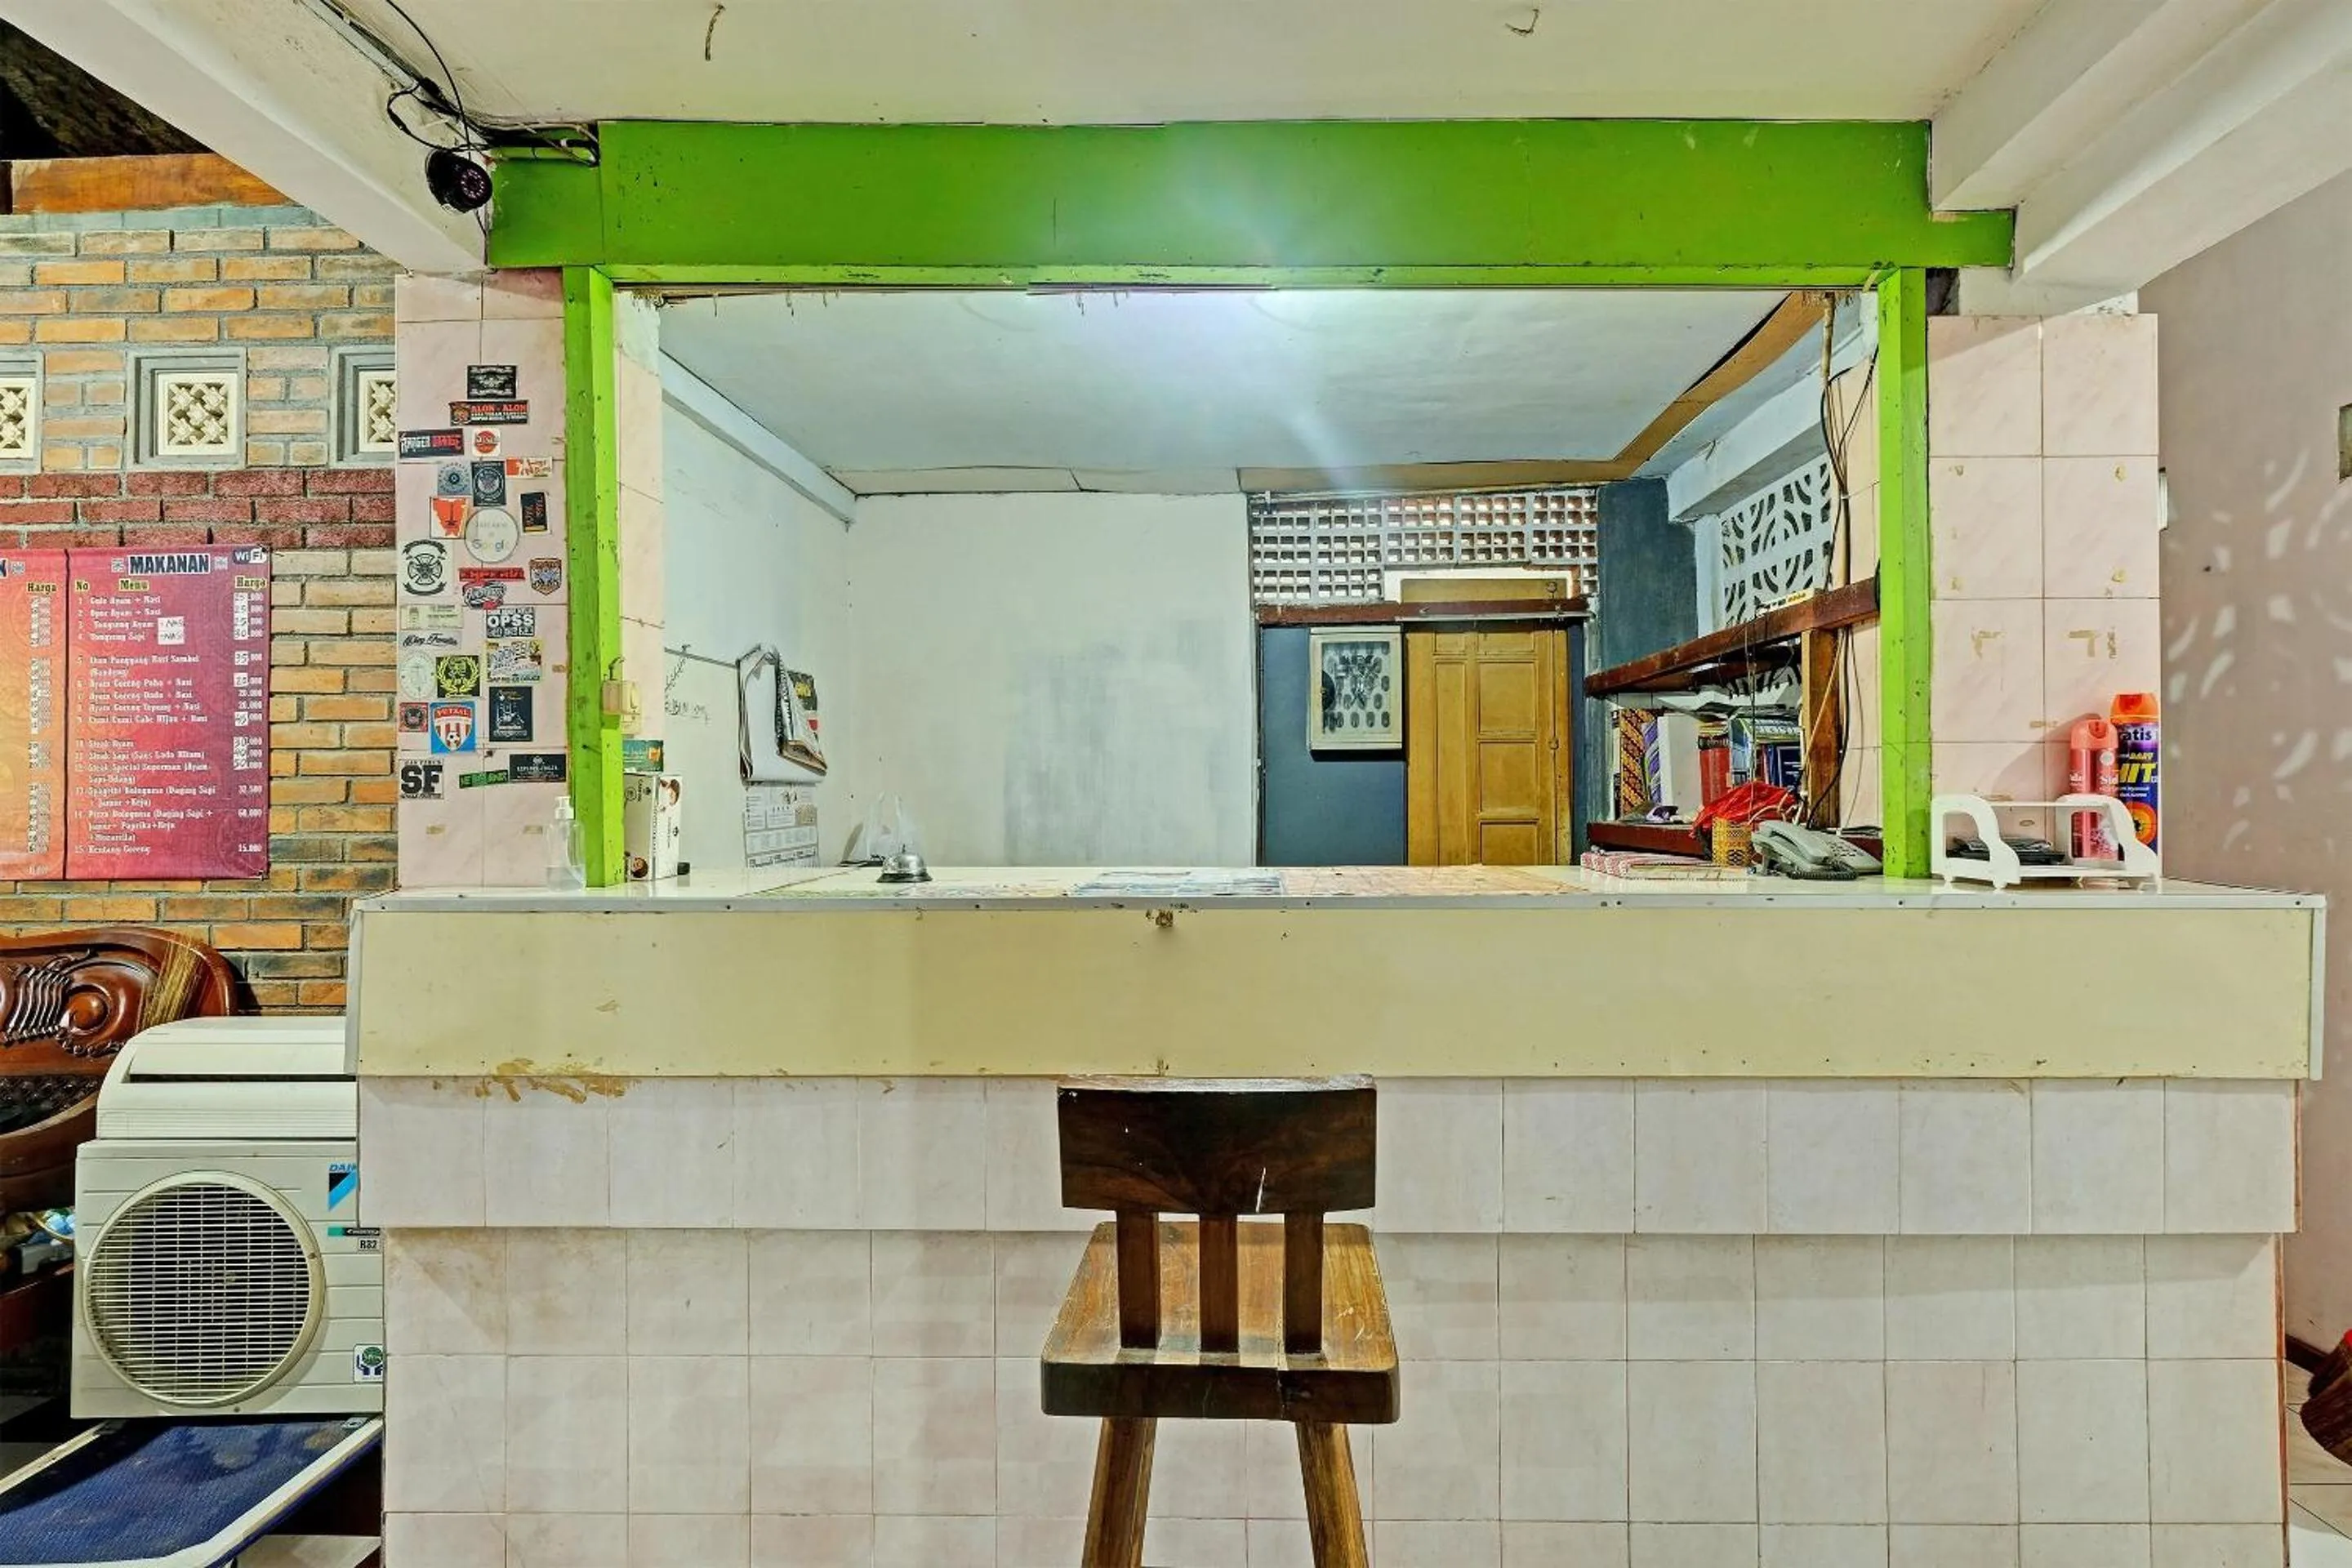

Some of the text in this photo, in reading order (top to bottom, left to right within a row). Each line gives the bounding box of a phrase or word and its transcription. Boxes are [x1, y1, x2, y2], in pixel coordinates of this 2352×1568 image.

[128, 555, 211, 574] MAKANAN
[28, 582, 57, 595] Harga
[76, 577, 267, 590] No Menu Harga
[2120, 728, 2152, 741] atis
[401, 764, 443, 794] SF
[359, 1240, 377, 1250] R32
